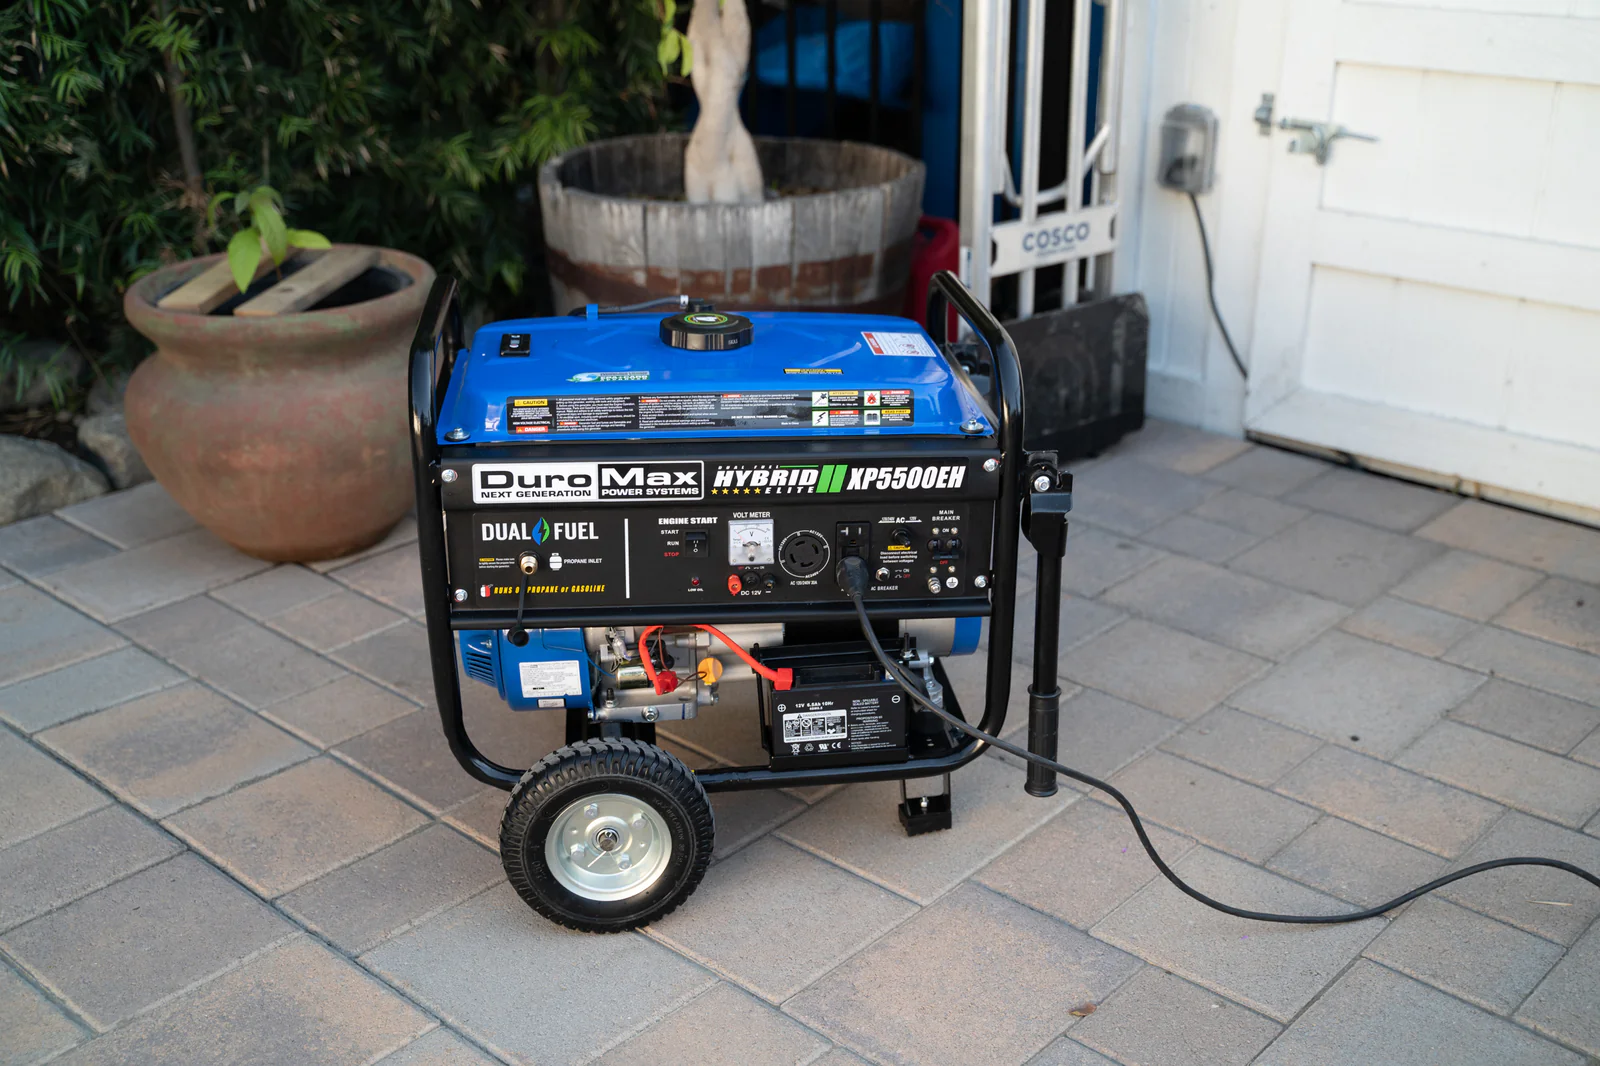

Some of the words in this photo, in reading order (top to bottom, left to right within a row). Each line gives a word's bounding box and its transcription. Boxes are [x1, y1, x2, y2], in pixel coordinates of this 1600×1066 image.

[1022, 222, 1090, 252] COSCO
[480, 470, 592, 489] Duro
[601, 467, 698, 487] Max
[714, 468, 820, 487] HYBRID
[846, 466, 966, 490] XP5500EH
[481, 490, 512, 498] NEXT
[516, 490, 591, 498] GENERATION
[602, 488, 643, 496] POWER
[646, 487, 699, 495] SYSTEMS
[482, 523, 532, 541] DUAL
[554, 522, 599, 540] FUEL
[494, 586, 513, 594] RUNS
[527, 585, 558, 594] PROPANE
[571, 585, 605, 593] GASOLINE
